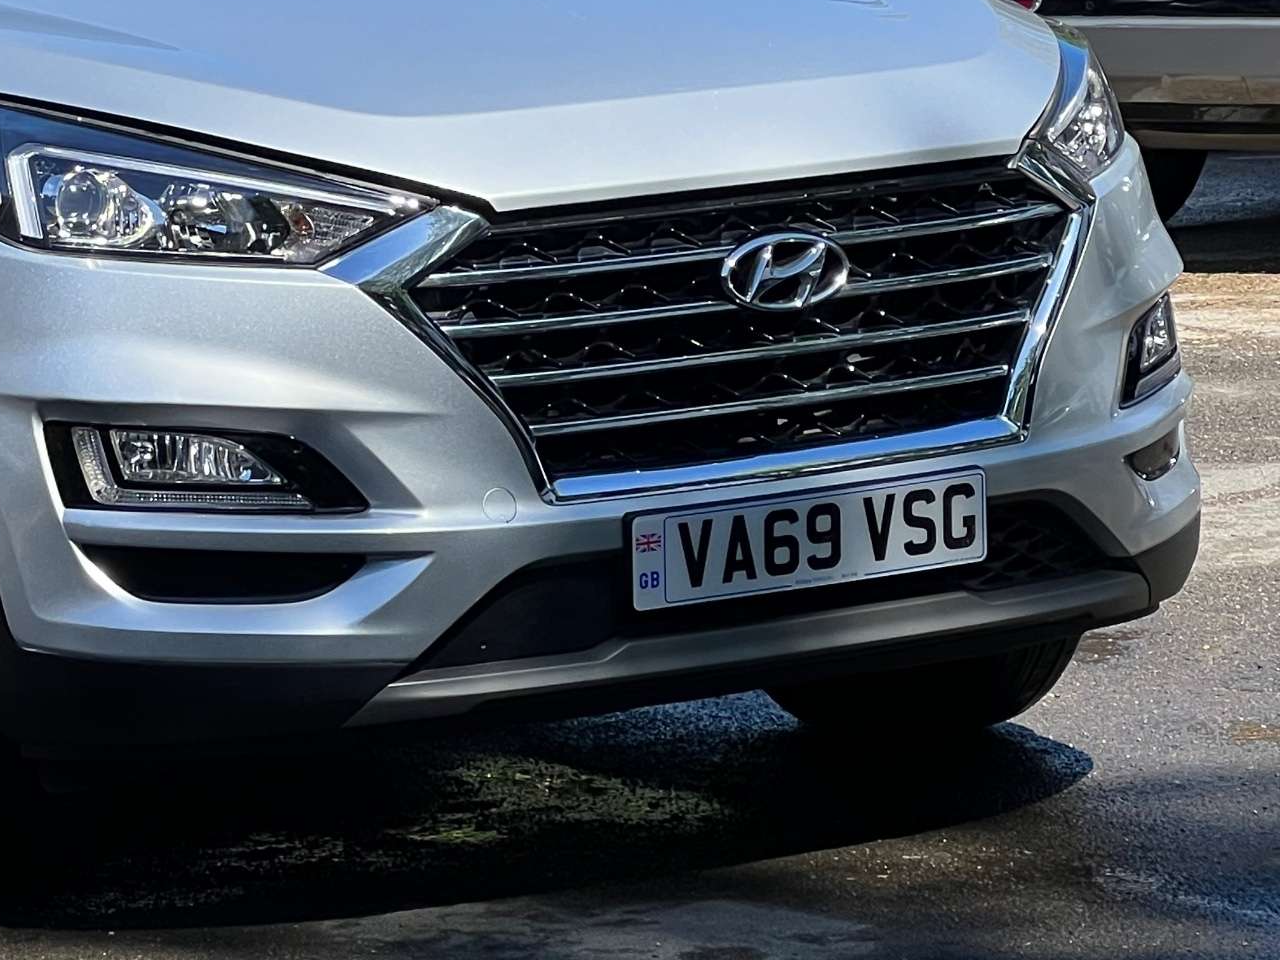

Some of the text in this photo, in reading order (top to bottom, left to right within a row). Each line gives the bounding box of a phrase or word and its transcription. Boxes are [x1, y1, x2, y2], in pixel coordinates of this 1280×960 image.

[678, 482, 977, 589] VA69 VSG
[639, 571, 660, 590] GB
